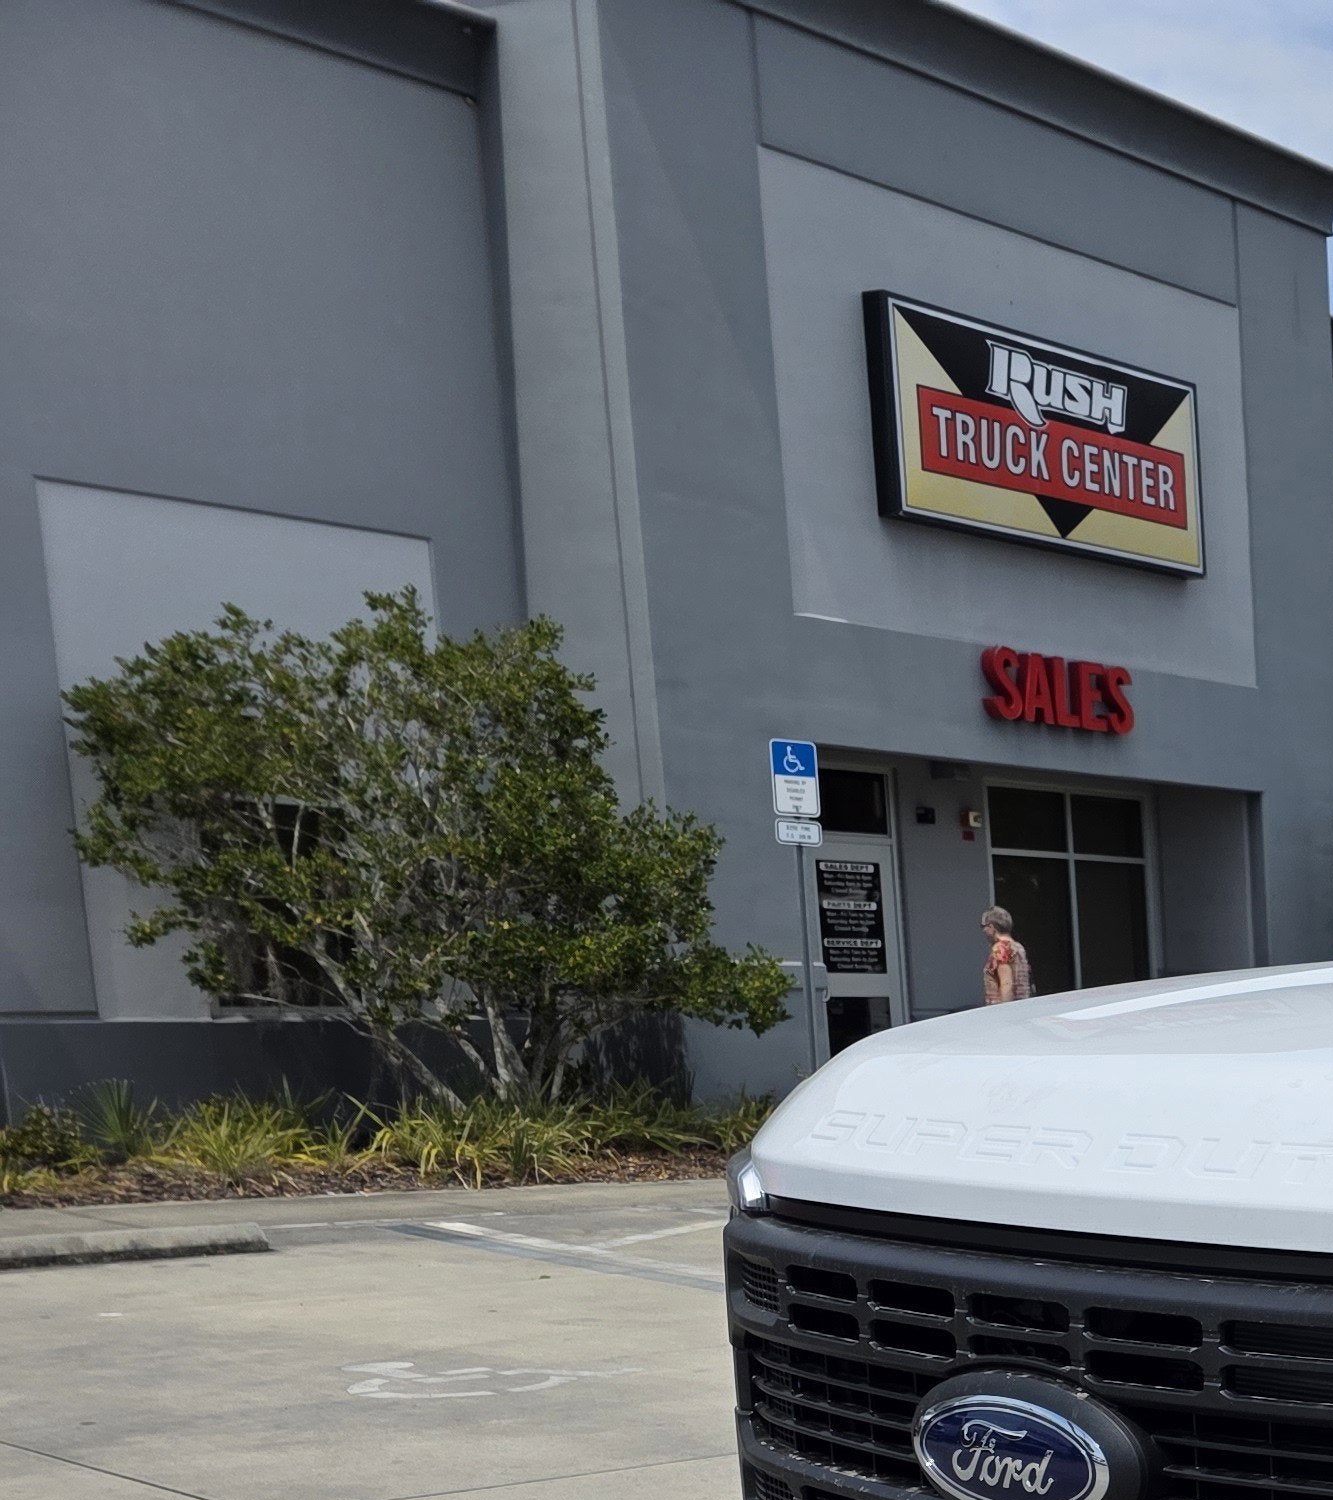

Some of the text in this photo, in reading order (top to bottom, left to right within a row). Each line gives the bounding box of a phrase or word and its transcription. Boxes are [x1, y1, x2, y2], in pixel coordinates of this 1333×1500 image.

[931, 406, 1176, 511] TRUCK CENTER
[980, 645, 1134, 735] SALES
[808, 1110, 1096, 1172] SUPER
[951, 1419, 1055, 1496] Ford
